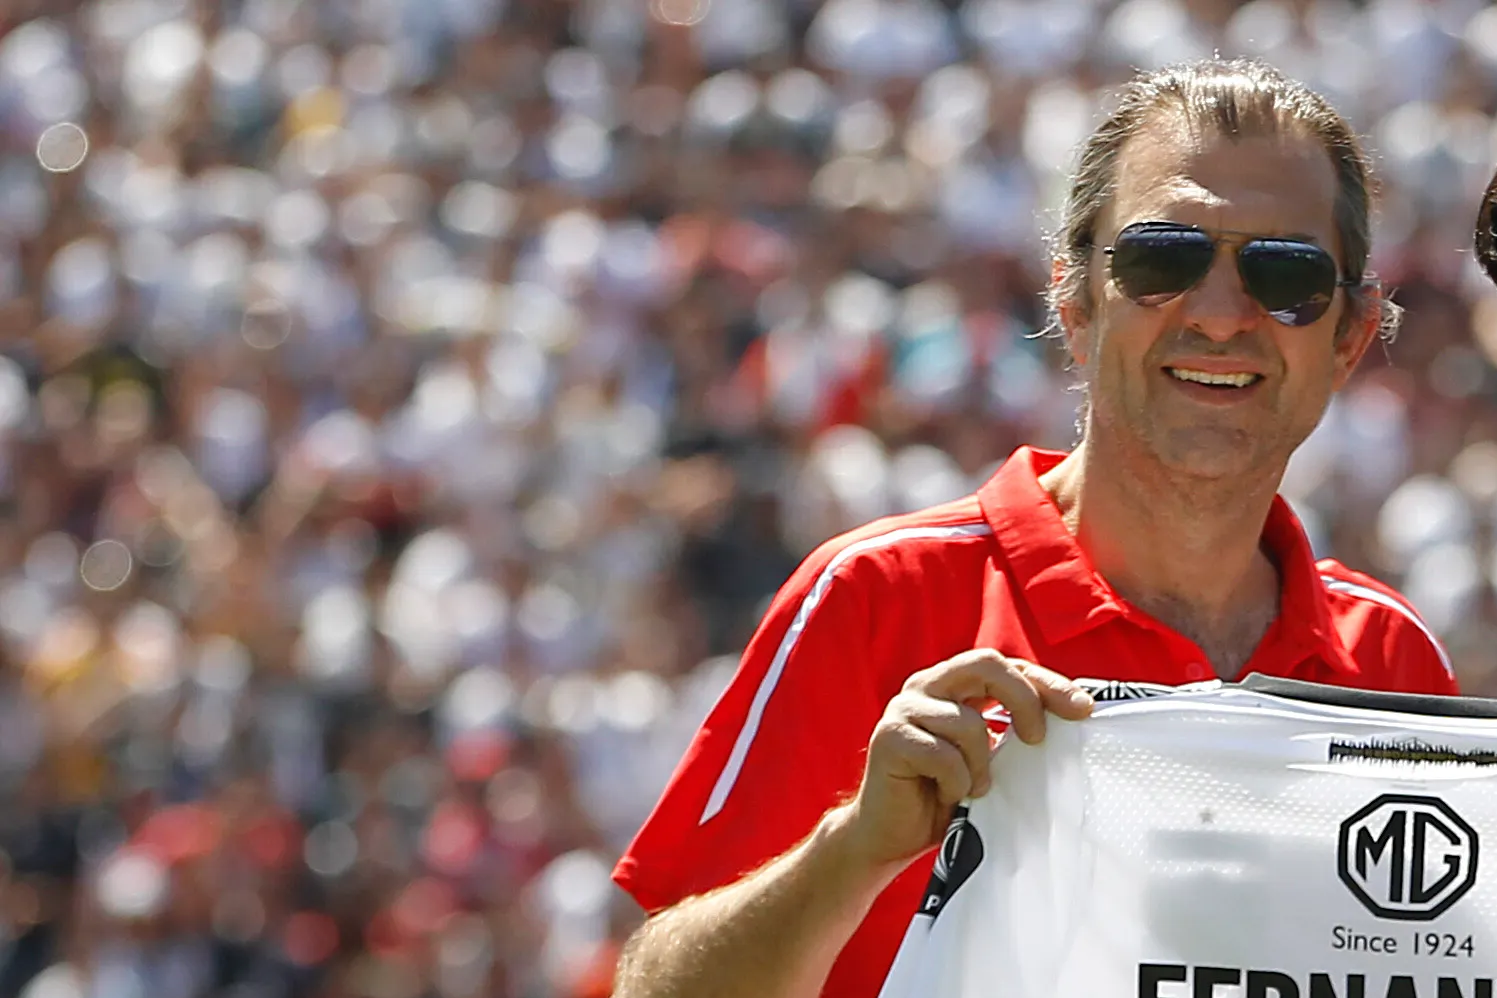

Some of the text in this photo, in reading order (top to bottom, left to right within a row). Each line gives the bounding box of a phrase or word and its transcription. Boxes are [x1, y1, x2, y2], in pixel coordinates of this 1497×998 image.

[1355, 811, 1461, 904] MG
[1332, 926, 1474, 958] Since 1924
